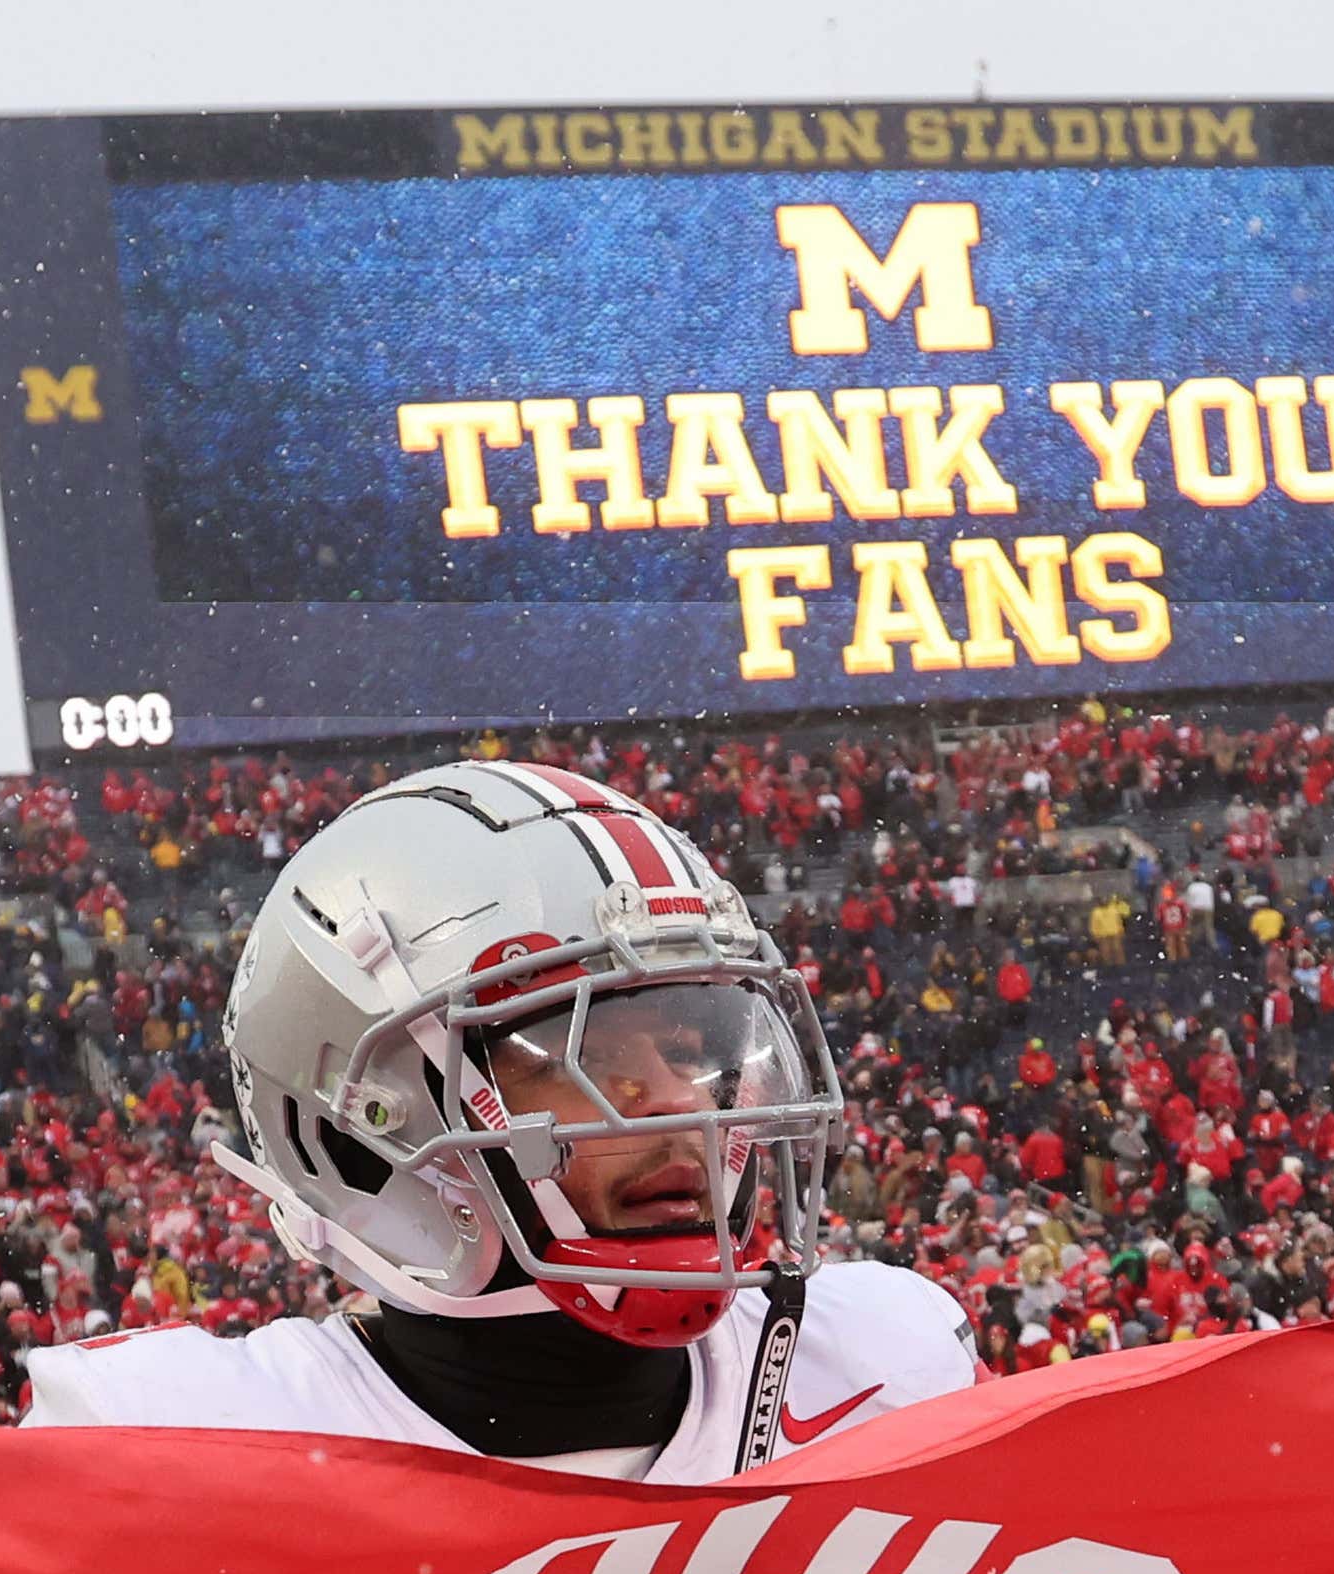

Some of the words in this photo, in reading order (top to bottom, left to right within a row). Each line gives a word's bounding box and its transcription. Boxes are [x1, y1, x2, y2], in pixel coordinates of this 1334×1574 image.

[453, 108, 882, 166] MICHIGAN
[904, 106, 1258, 162] STADIUM
[773, 200, 995, 358] M
[19, 363, 105, 425] M
[395, 382, 1021, 542] THANK
[724, 531, 1174, 683] FANS
[60, 691, 174, 751] 0:00
